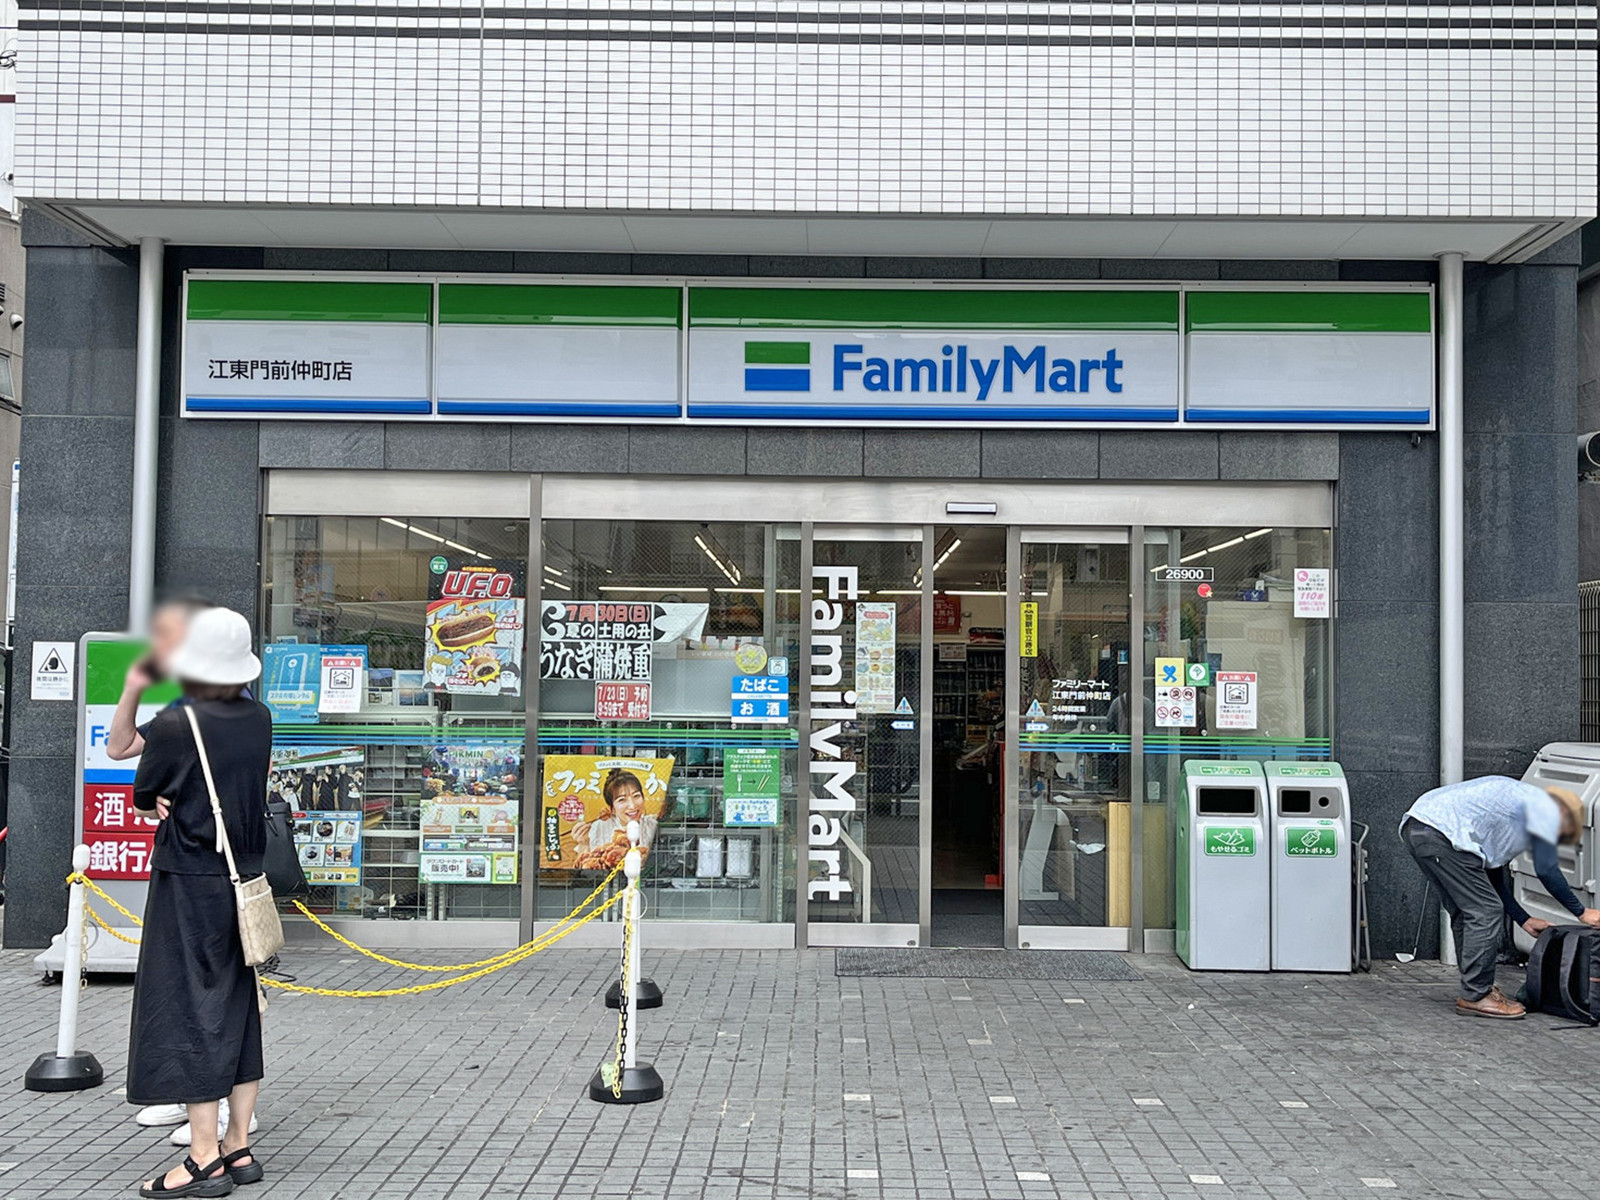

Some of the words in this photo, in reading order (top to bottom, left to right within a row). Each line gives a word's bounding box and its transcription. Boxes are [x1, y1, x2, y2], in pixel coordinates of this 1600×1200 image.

[208, 359, 352, 381] 江東門前仲町店
[833, 344, 1123, 401] FamilyMart
[1165, 569, 1205, 581] 26900
[442, 571, 513, 599] U.F.O.
[565, 604, 651, 622] 7月30日(日)
[565, 622, 651, 639] 夏の土用の丑
[540, 641, 651, 680] うなぎ蒲焼重
[740, 678, 780, 692] たばこ
[1052, 679, 1110, 690] ファミリーマート
[597, 686, 629, 701] 7/23(日)
[634, 686, 648, 701] 予約
[1052, 690, 1111, 701] 江東門前仲町店
[740, 702, 780, 716] お酒
[553, 770, 601, 794] ファミ
[90, 840, 153, 873] 銀行
[1211, 846, 1250, 854] もやせるゴミ
[1290, 847, 1333, 855] ペットボトル
